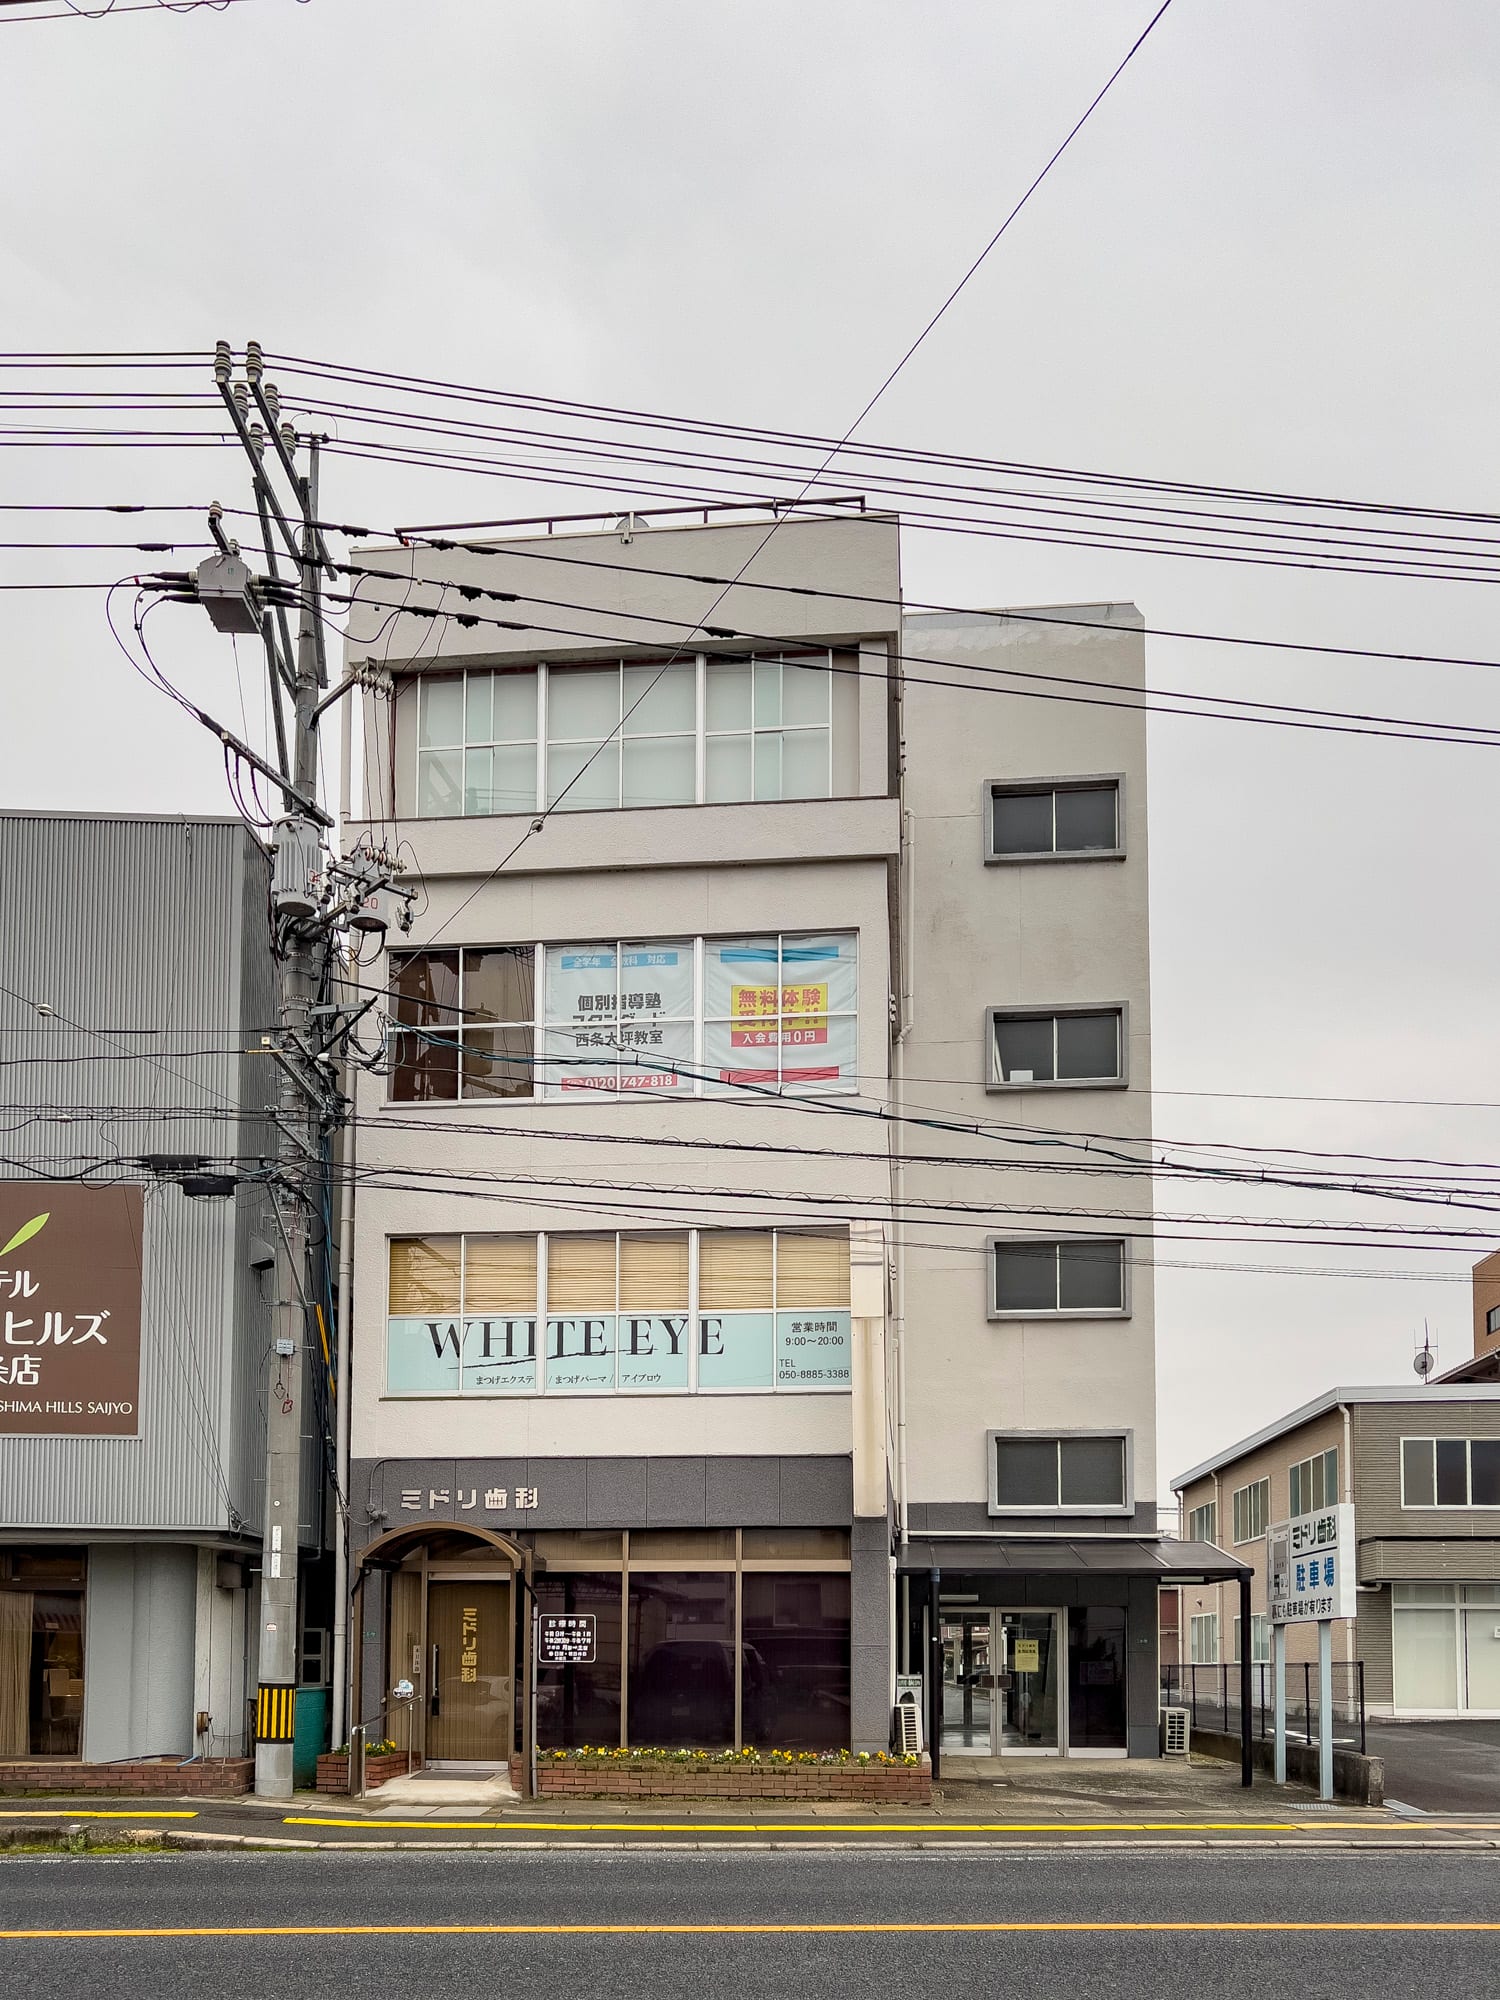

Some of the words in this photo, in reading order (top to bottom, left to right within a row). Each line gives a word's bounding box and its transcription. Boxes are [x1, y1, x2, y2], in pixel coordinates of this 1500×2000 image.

[577, 992, 662, 1012] 個別指導塾
[738, 987, 821, 1008] 無料体験
[575, 1029, 663, 1047] 西条大坪教室
[742, 1030, 816, 1045] 入会費用0円
[585, 1075, 673, 1089] 0120747-818
[5, 1309, 111, 1346] ヒルズ
[791, 1321, 838, 1333] 営業時間
[424, 1320, 608, 1360] WHITE
[626, 1318, 725, 1356] EYE
[779, 1358, 796, 1368] TEL
[779, 1369, 850, 1379] 050-8885-3388
[46, 1401, 82, 1414] HILLS
[87, 1401, 133, 1416] SAIJYO
[401, 1487, 539, 1510] ミドリ歯科
[1292, 1515, 1337, 1549] ミドリ歯科
[1296, 1556, 1335, 1592] 駐車場
[461, 1607, 478, 1683] ミドリ歯科
